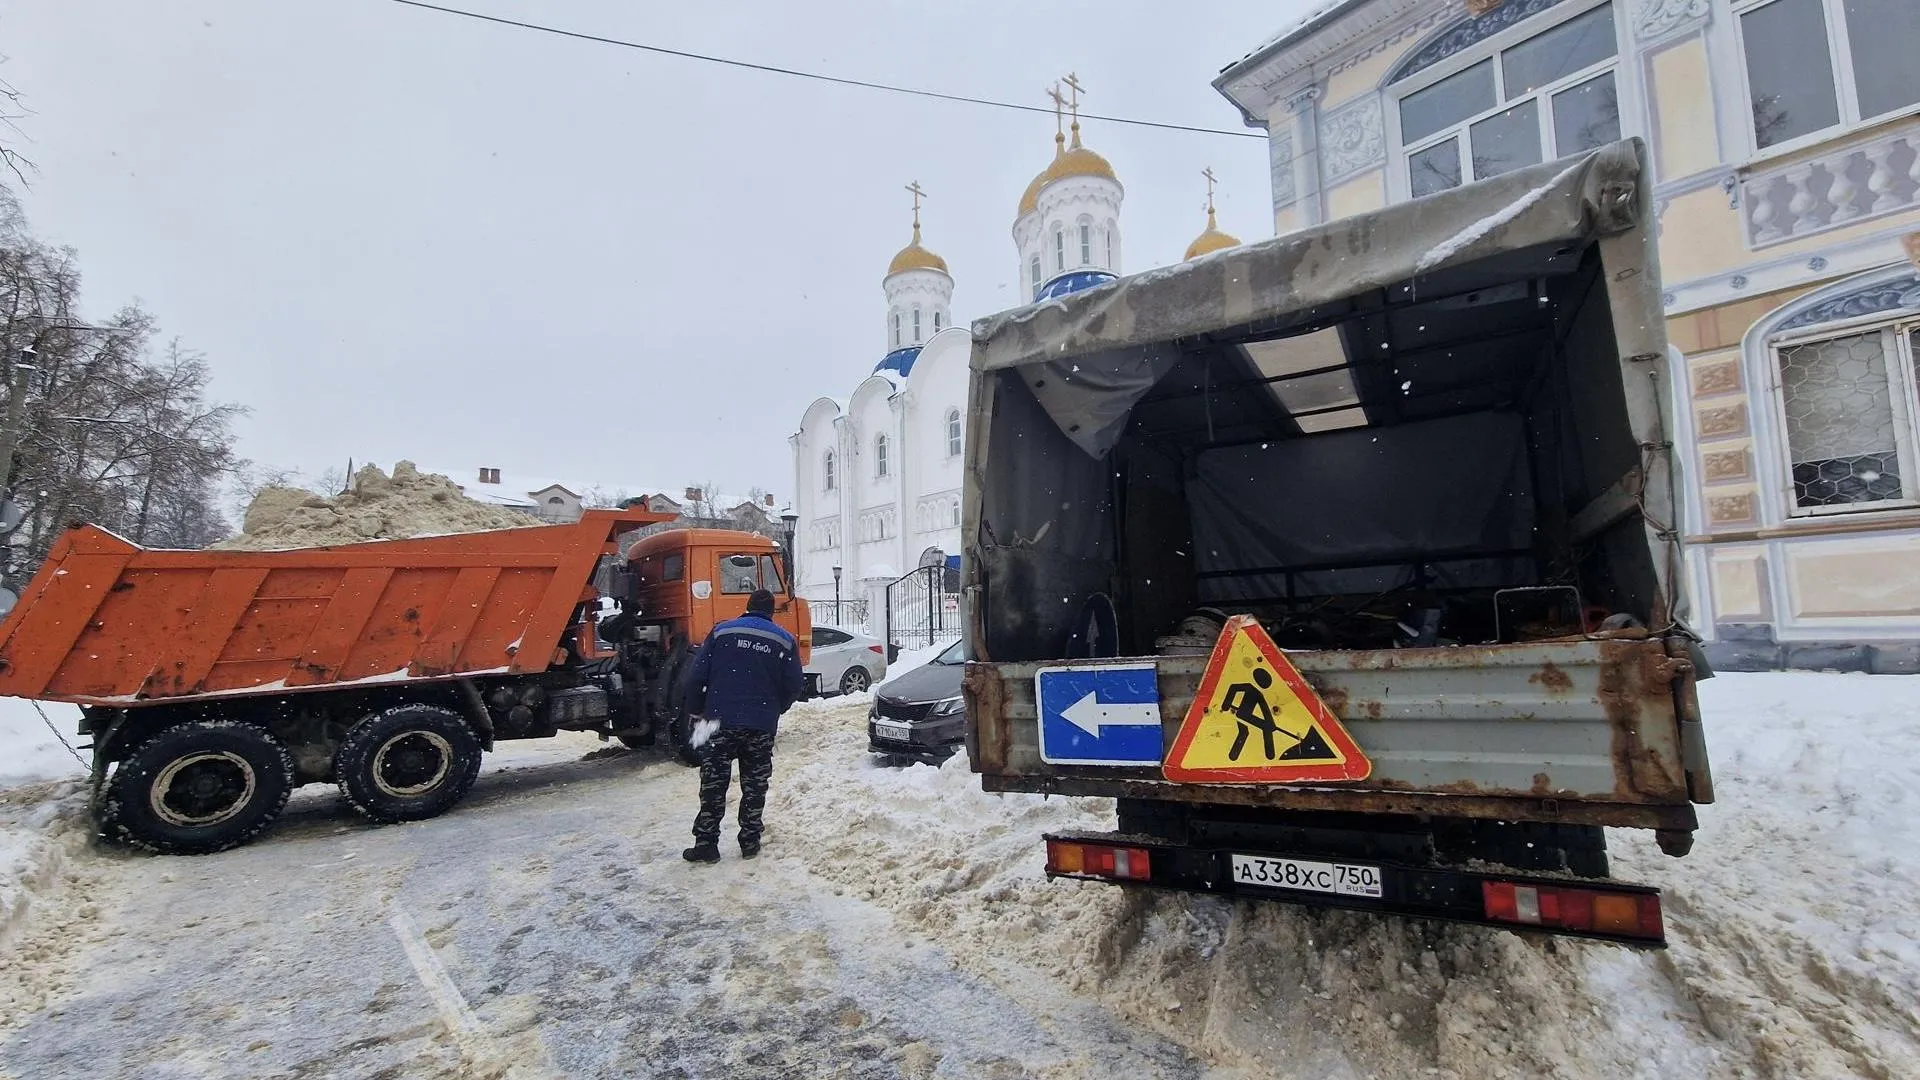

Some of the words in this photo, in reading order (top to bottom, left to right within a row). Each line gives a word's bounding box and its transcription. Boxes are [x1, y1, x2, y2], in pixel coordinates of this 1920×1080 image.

[737, 639, 752, 649] МБУ
[1241, 859, 1332, 889] А338ХС
[1335, 865, 1374, 886] 750
[1346, 884, 1366, 893] RUS
